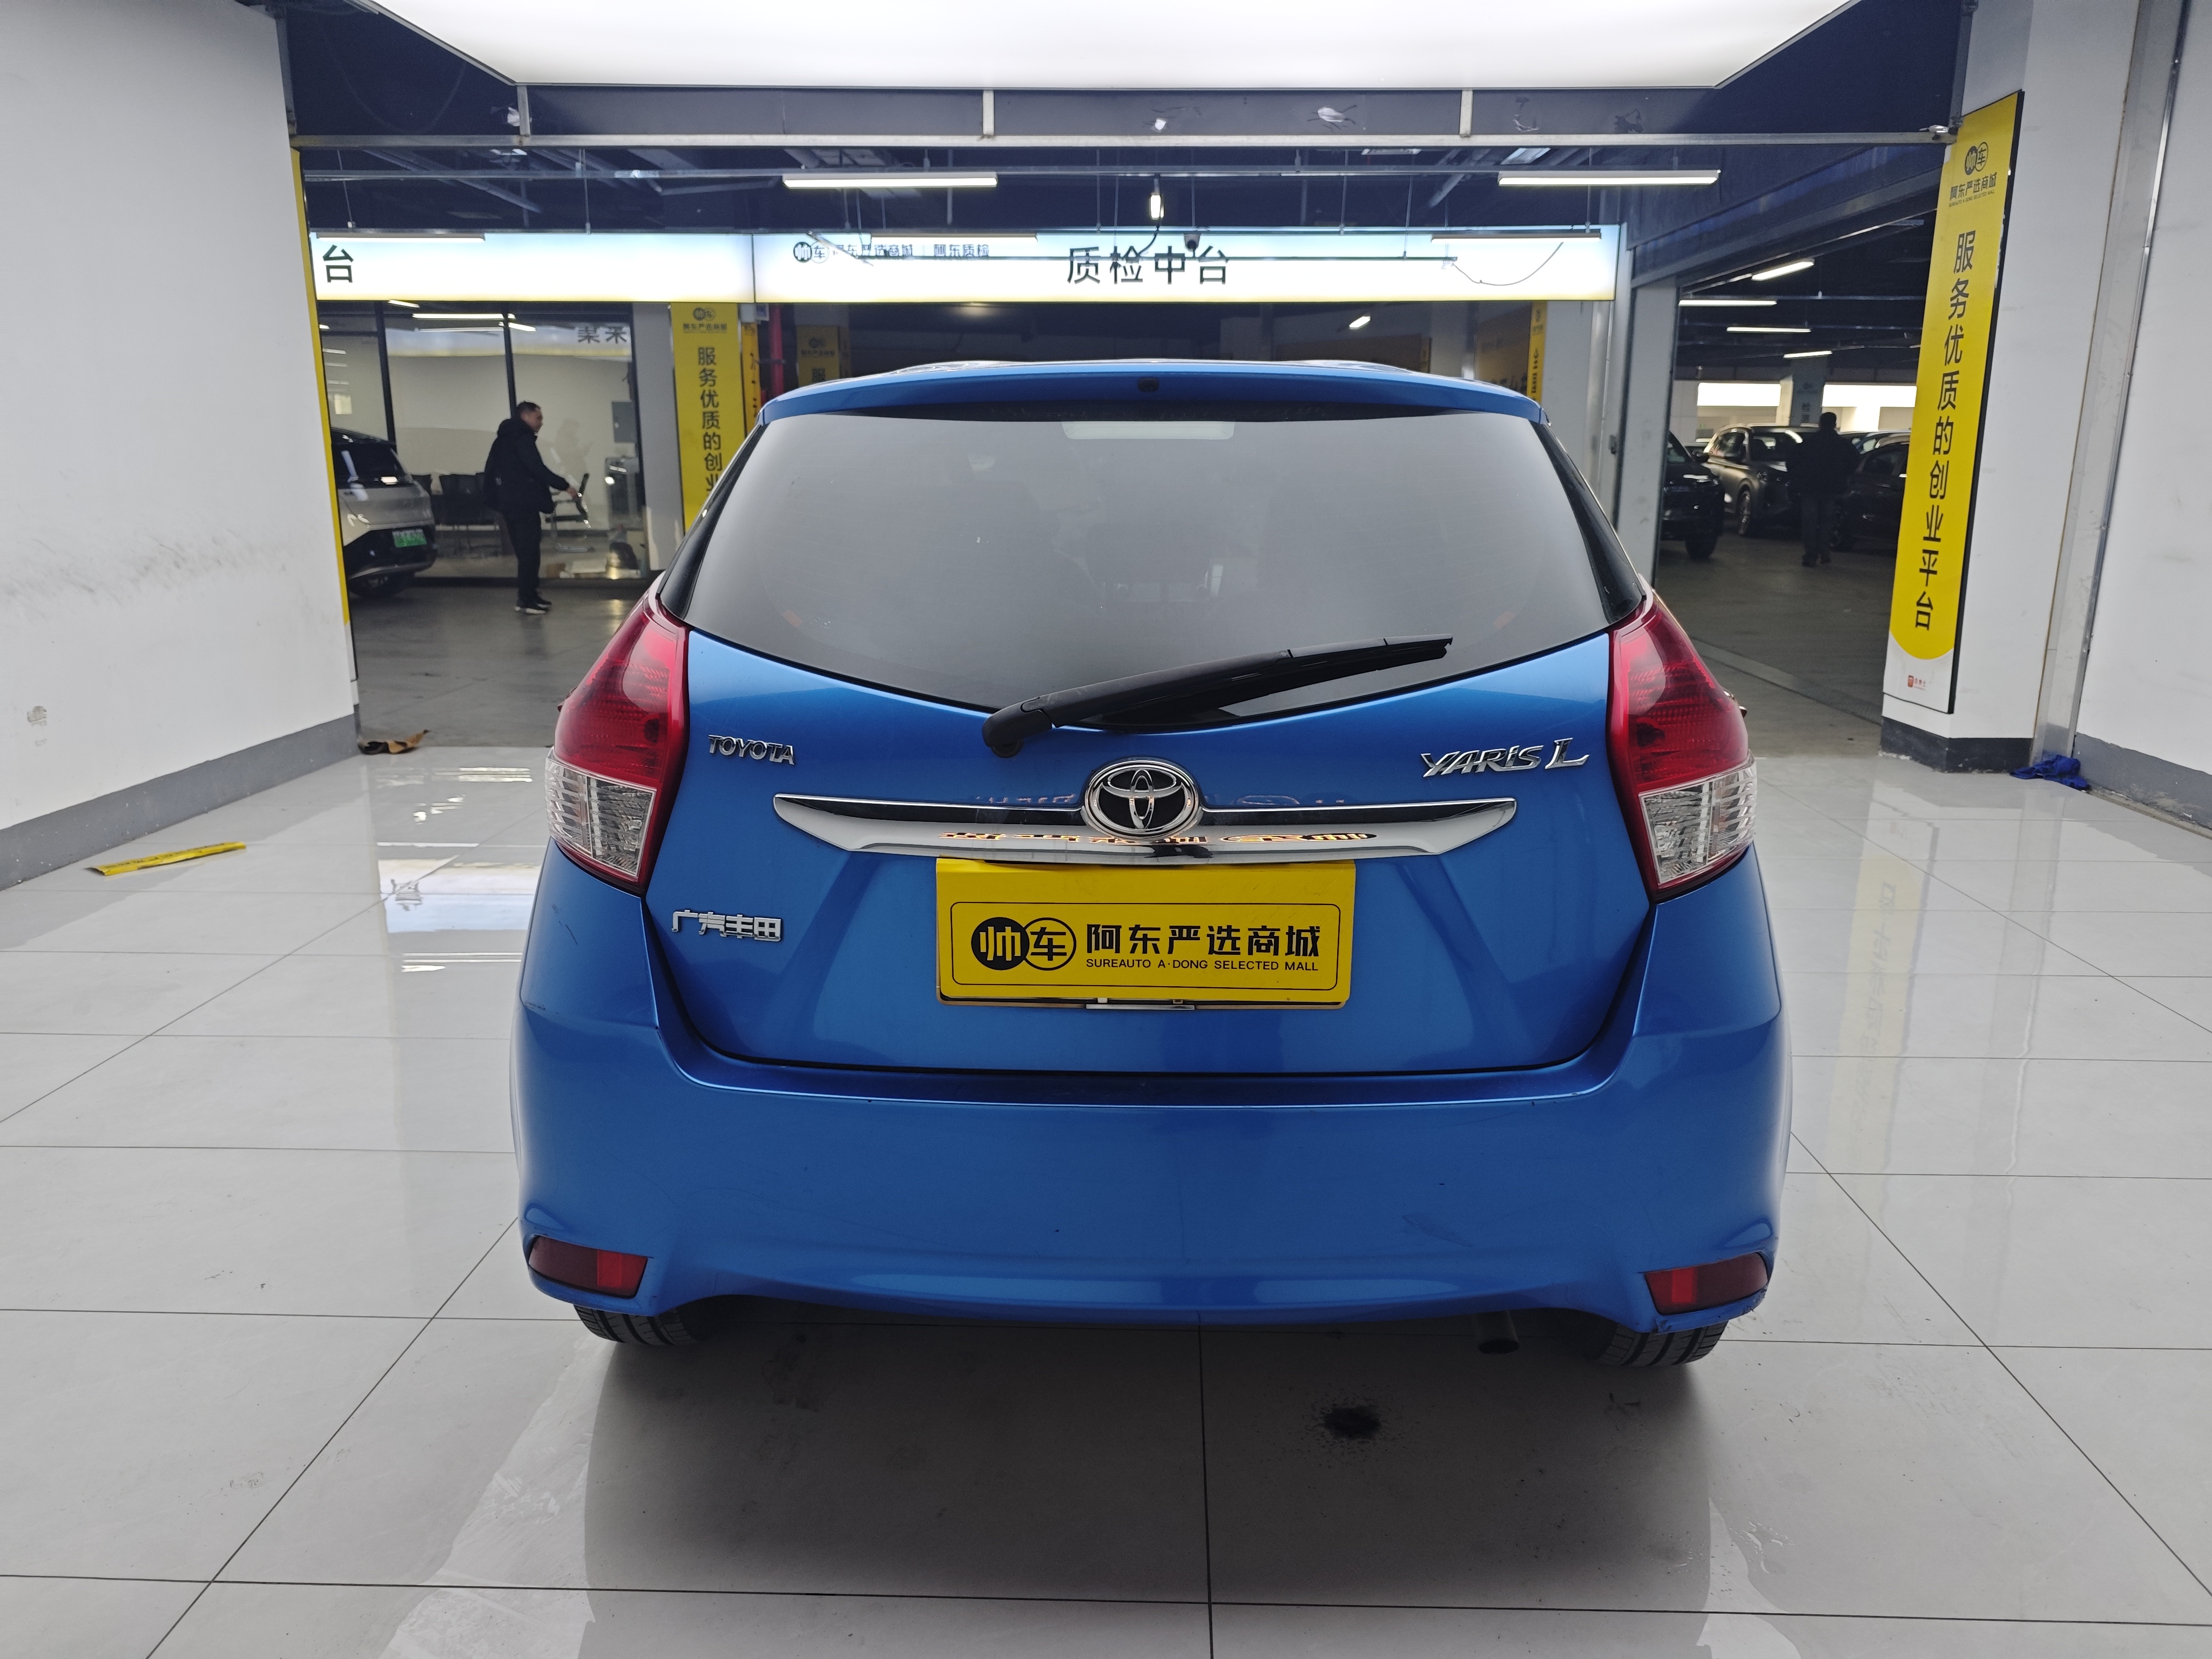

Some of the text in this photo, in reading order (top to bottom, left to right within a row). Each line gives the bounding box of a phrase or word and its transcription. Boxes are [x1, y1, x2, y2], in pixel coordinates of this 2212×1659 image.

[1950, 172, 1997, 201] 阿东严选商城
[322, 244, 354, 284] 台
[1067, 246, 1230, 285] 质检中台
[1915, 230, 1976, 631] 服务优质的创业平台
[708, 734, 795, 765] TOYOTA
[1420, 737, 1590, 778] YARIS L
[671, 909, 781, 942] 广汽丰田
[977, 923, 1320, 965] 帅车 阿东严选商城
[1086, 959, 1151, 969] SUREAUTO
[1214, 960, 1278, 970] SELECTED
[1285, 961, 1318, 971] MALL
